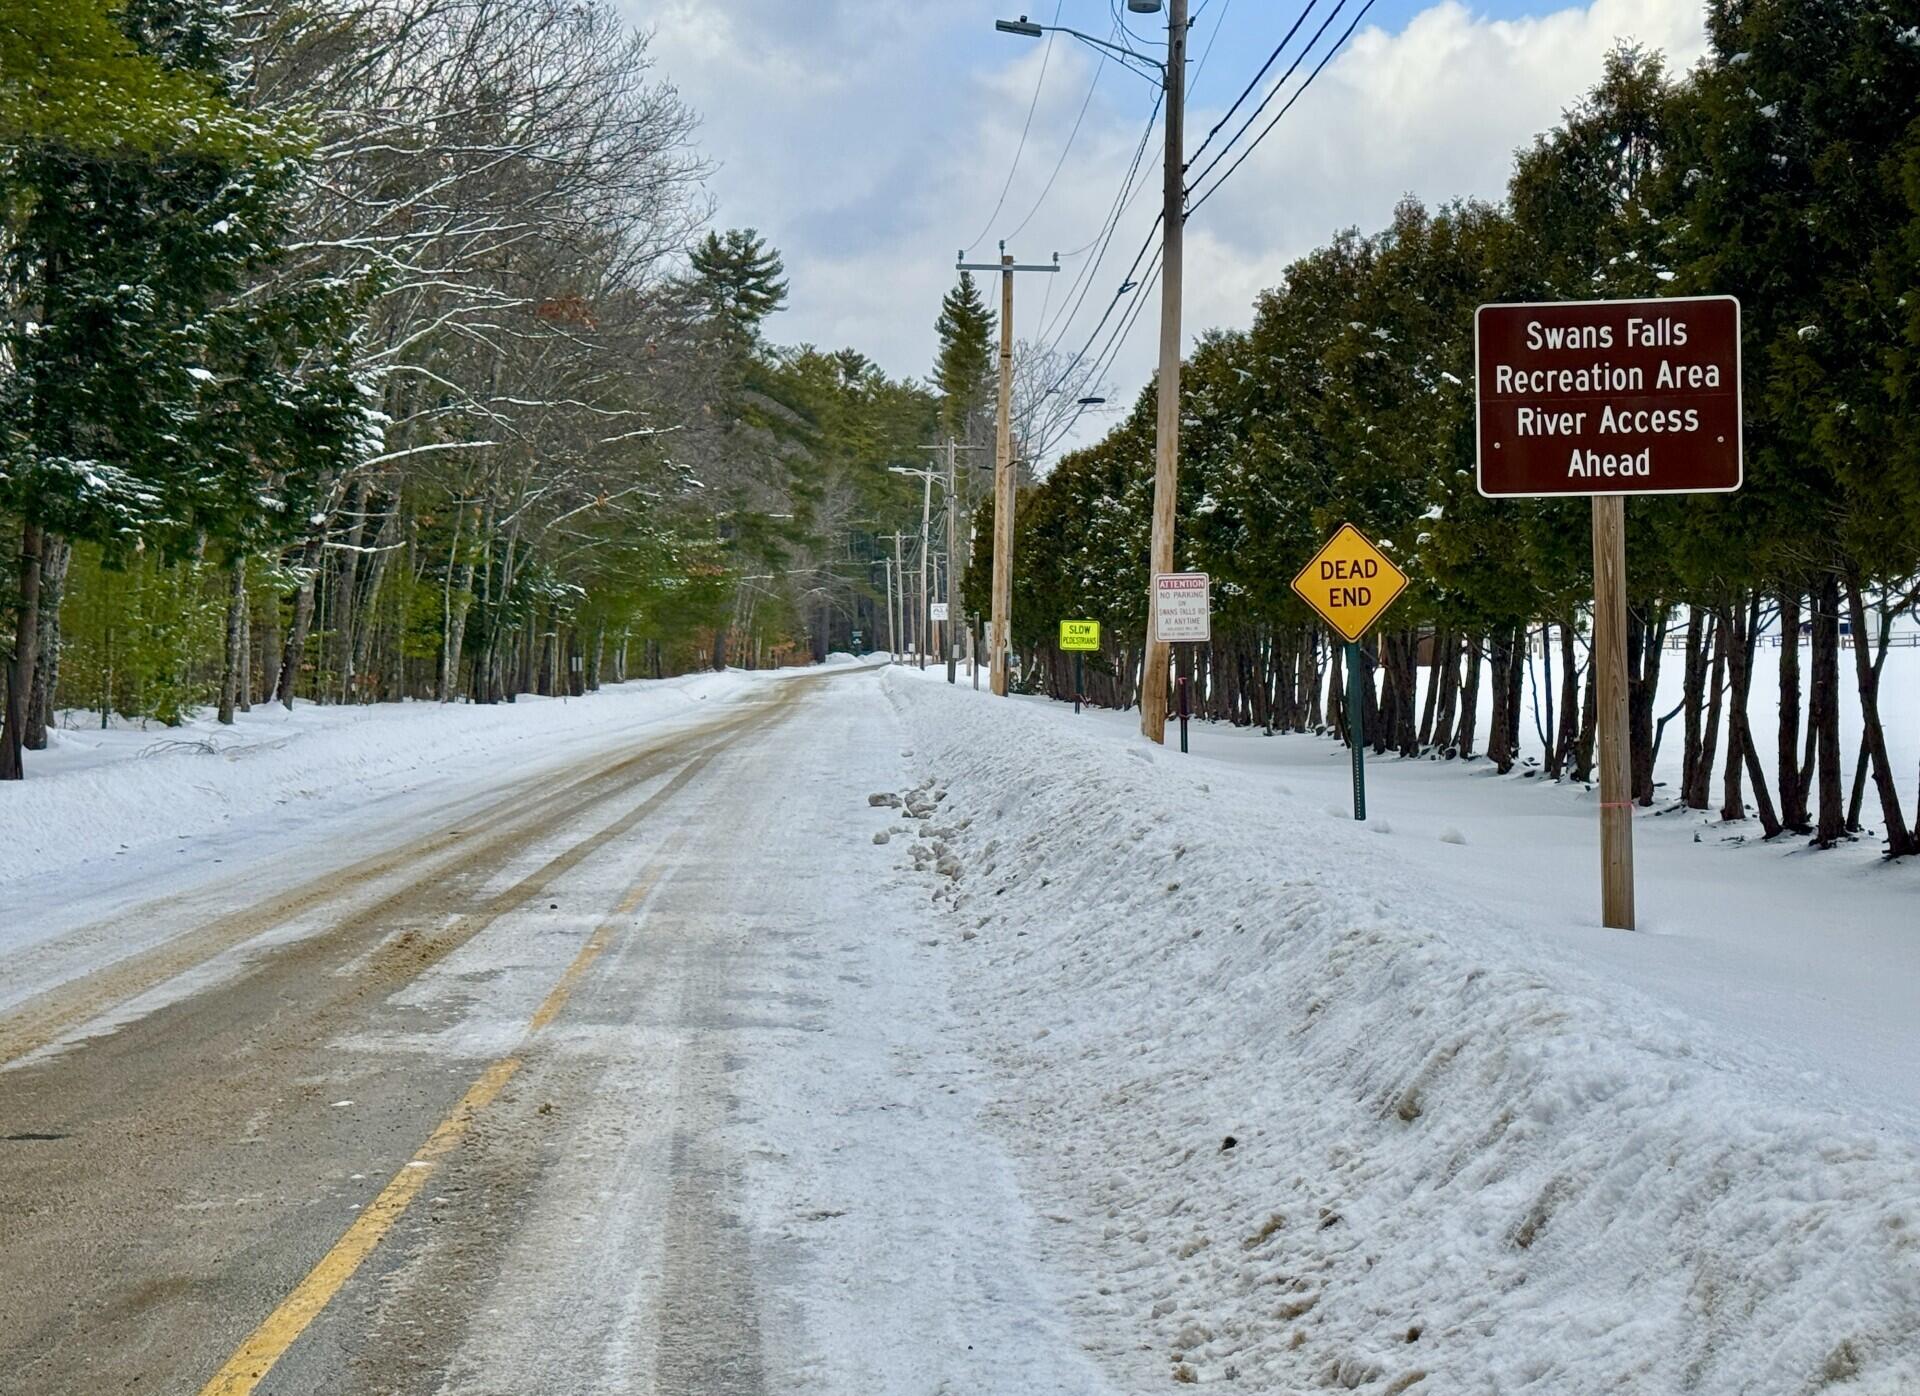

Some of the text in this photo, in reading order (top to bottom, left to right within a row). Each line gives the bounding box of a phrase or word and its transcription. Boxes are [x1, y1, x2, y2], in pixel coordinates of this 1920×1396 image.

[1526, 317, 1688, 351] Swans Falls
[1496, 359, 1720, 393] Recreation Area
[1517, 405, 1699, 436] River Access
[1567, 447, 1650, 477] Ahead
[1320, 559, 1378, 580] DEAD
[1159, 580, 1204, 588] ATTENTION
[1329, 587, 1371, 607] END
[1069, 625, 1090, 634] SLOW
